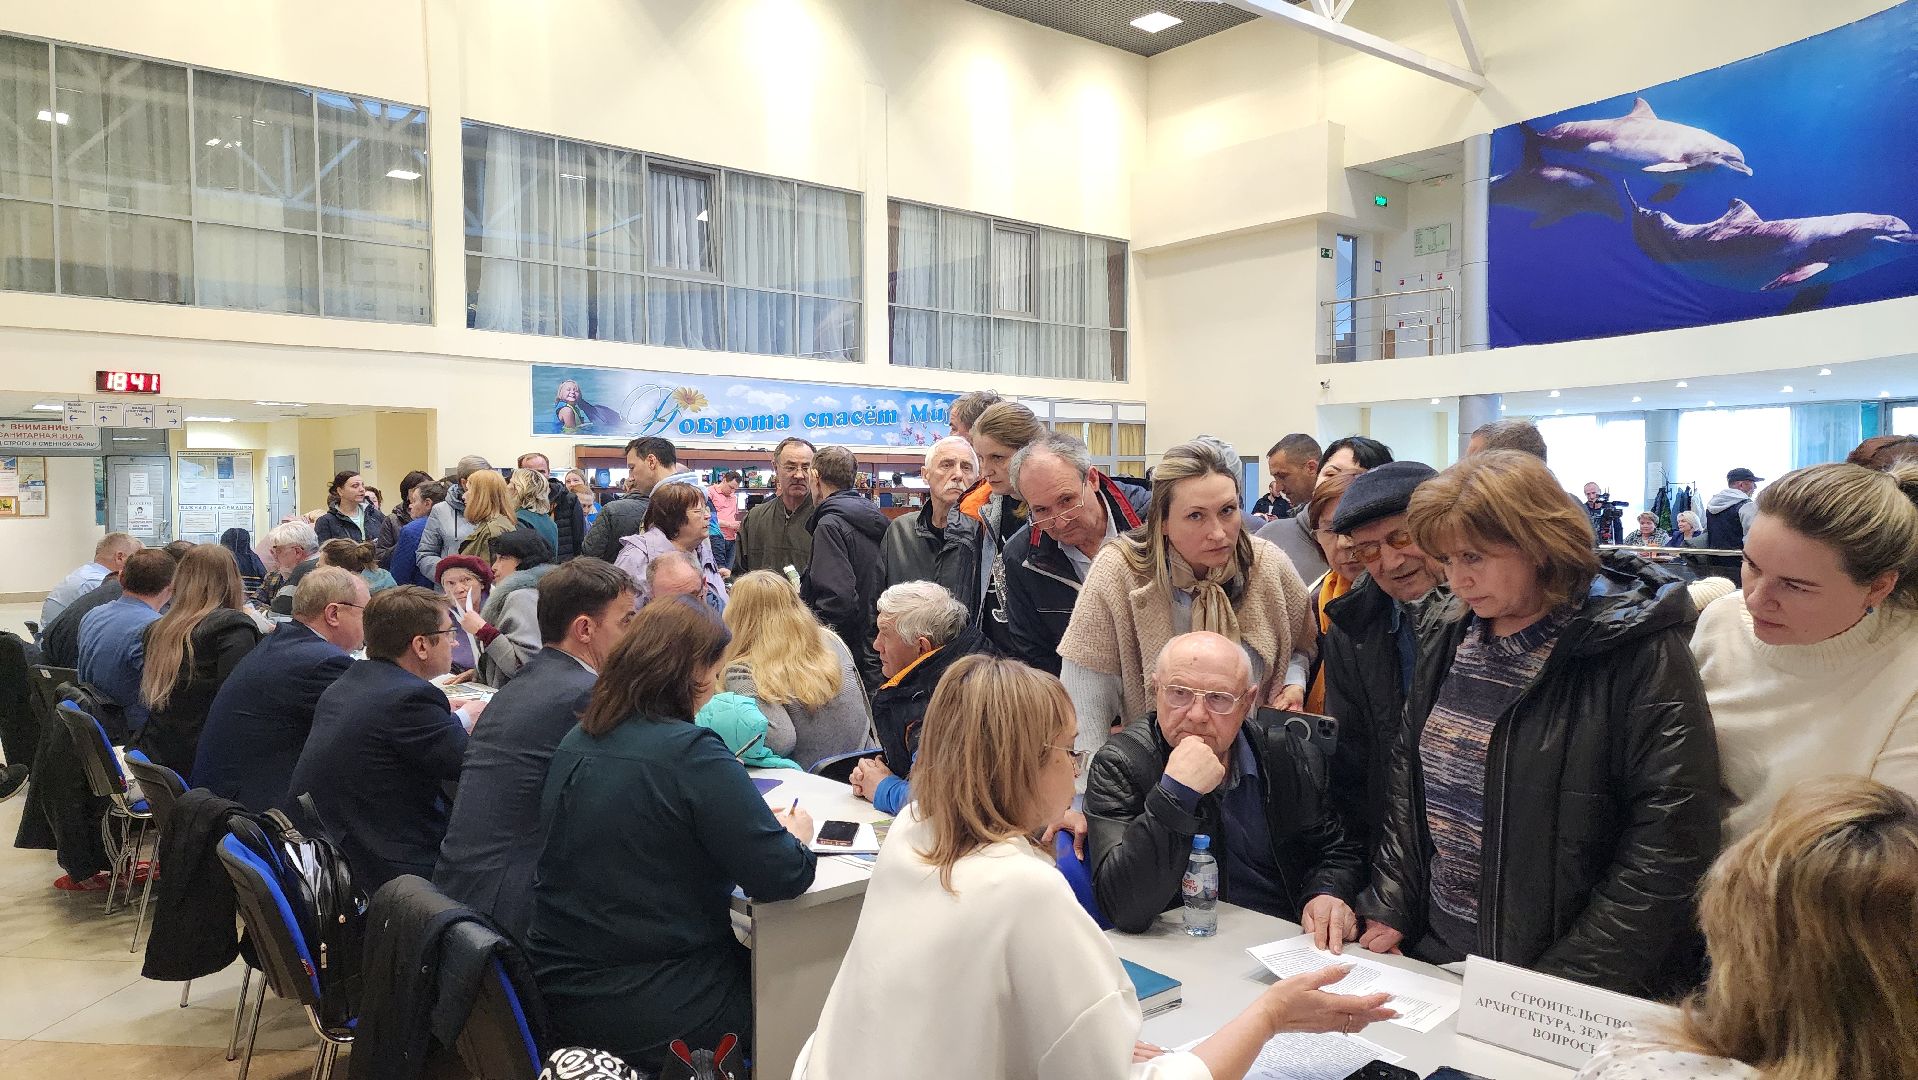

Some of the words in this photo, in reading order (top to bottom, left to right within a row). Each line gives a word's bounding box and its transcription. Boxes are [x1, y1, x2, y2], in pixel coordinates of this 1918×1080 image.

[803, 405, 898, 429] спасёт
[1475, 996, 1576, 1033] АРХИТЕКТУРА,
[1510, 990, 1633, 1029] СТРОИТЕЛЬСТВО
